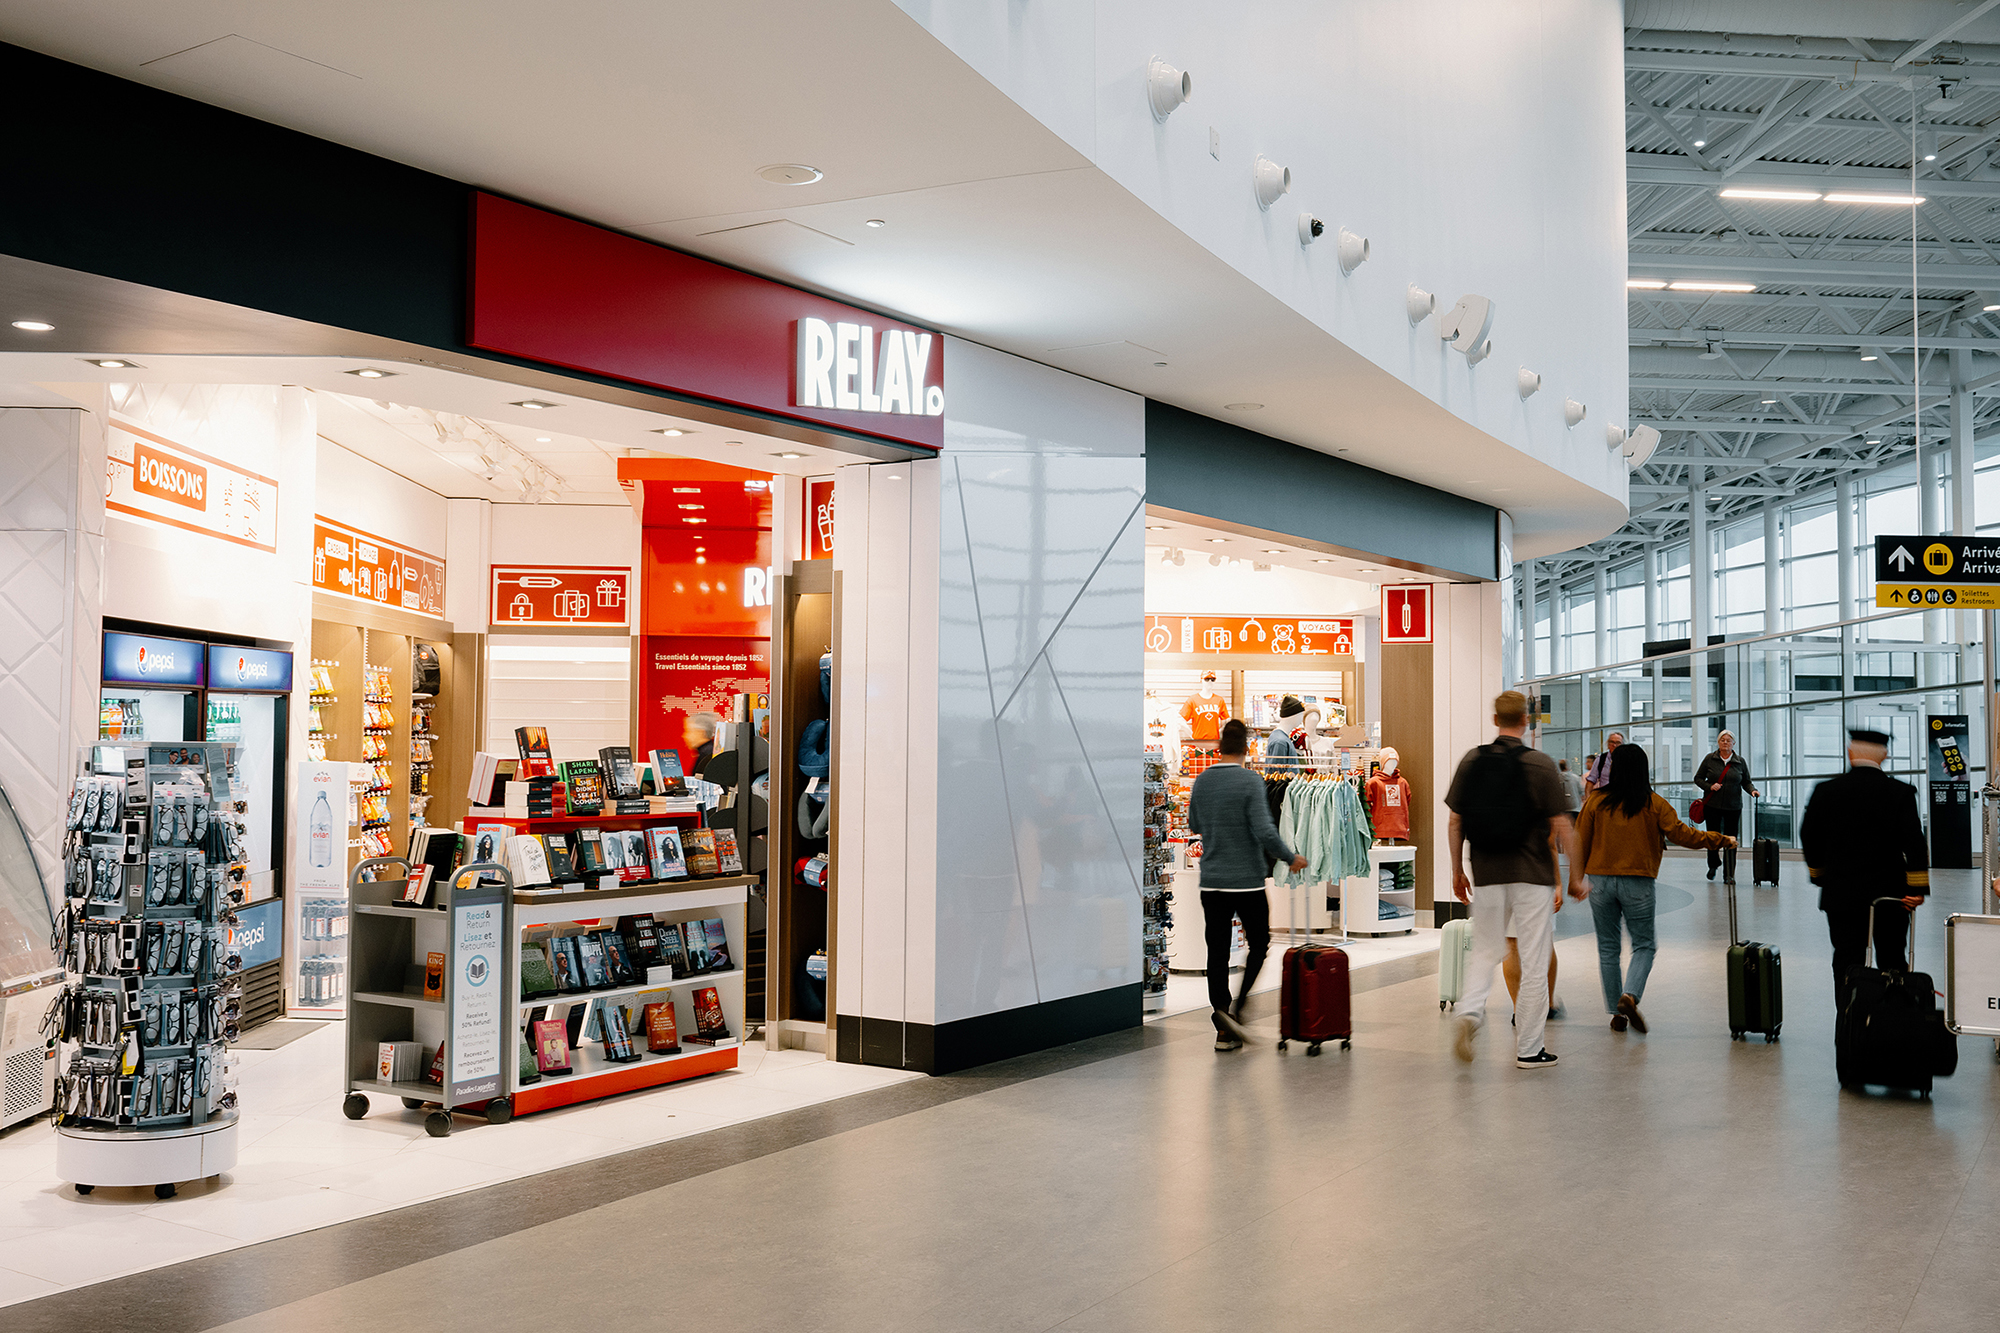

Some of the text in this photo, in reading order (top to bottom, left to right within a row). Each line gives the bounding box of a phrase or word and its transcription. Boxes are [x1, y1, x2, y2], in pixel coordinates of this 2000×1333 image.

[139, 455, 204, 501] BOISSONS
[1302, 624, 1336, 632] VOYAGE
[655, 653, 689, 661] Essentiels
[690, 653, 699, 661] de
[700, 654, 724, 662] voyage
[725, 654, 748, 662] depuis
[150, 652, 175, 673] pepsi
[677, 663, 711, 671] Essentials
[712, 663, 731, 671] since
[246, 661, 268, 680] pepsi
[569, 767, 598, 776] LAPENA
[575, 785, 597, 793] DIDN'T
[574, 798, 602, 806] COMING
[694, 836, 712, 844] KING
[466, 910, 491, 920] Read &
[466, 920, 490, 929] Return
[464, 932, 492, 942] Lisez et
[661, 935, 680, 946] STEEL
[460, 941, 496, 951] Retournez
[638, 938, 658, 948] OUVERT
[428, 957, 443, 965] KING
[466, 1012, 484, 1020] Receive
[461, 1018, 492, 1029] 50% Refund!
[463, 1051, 483, 1059] Recevez
[457, 1056, 495, 1068] remboursement
[473, 1066, 486, 1074] 50%!
